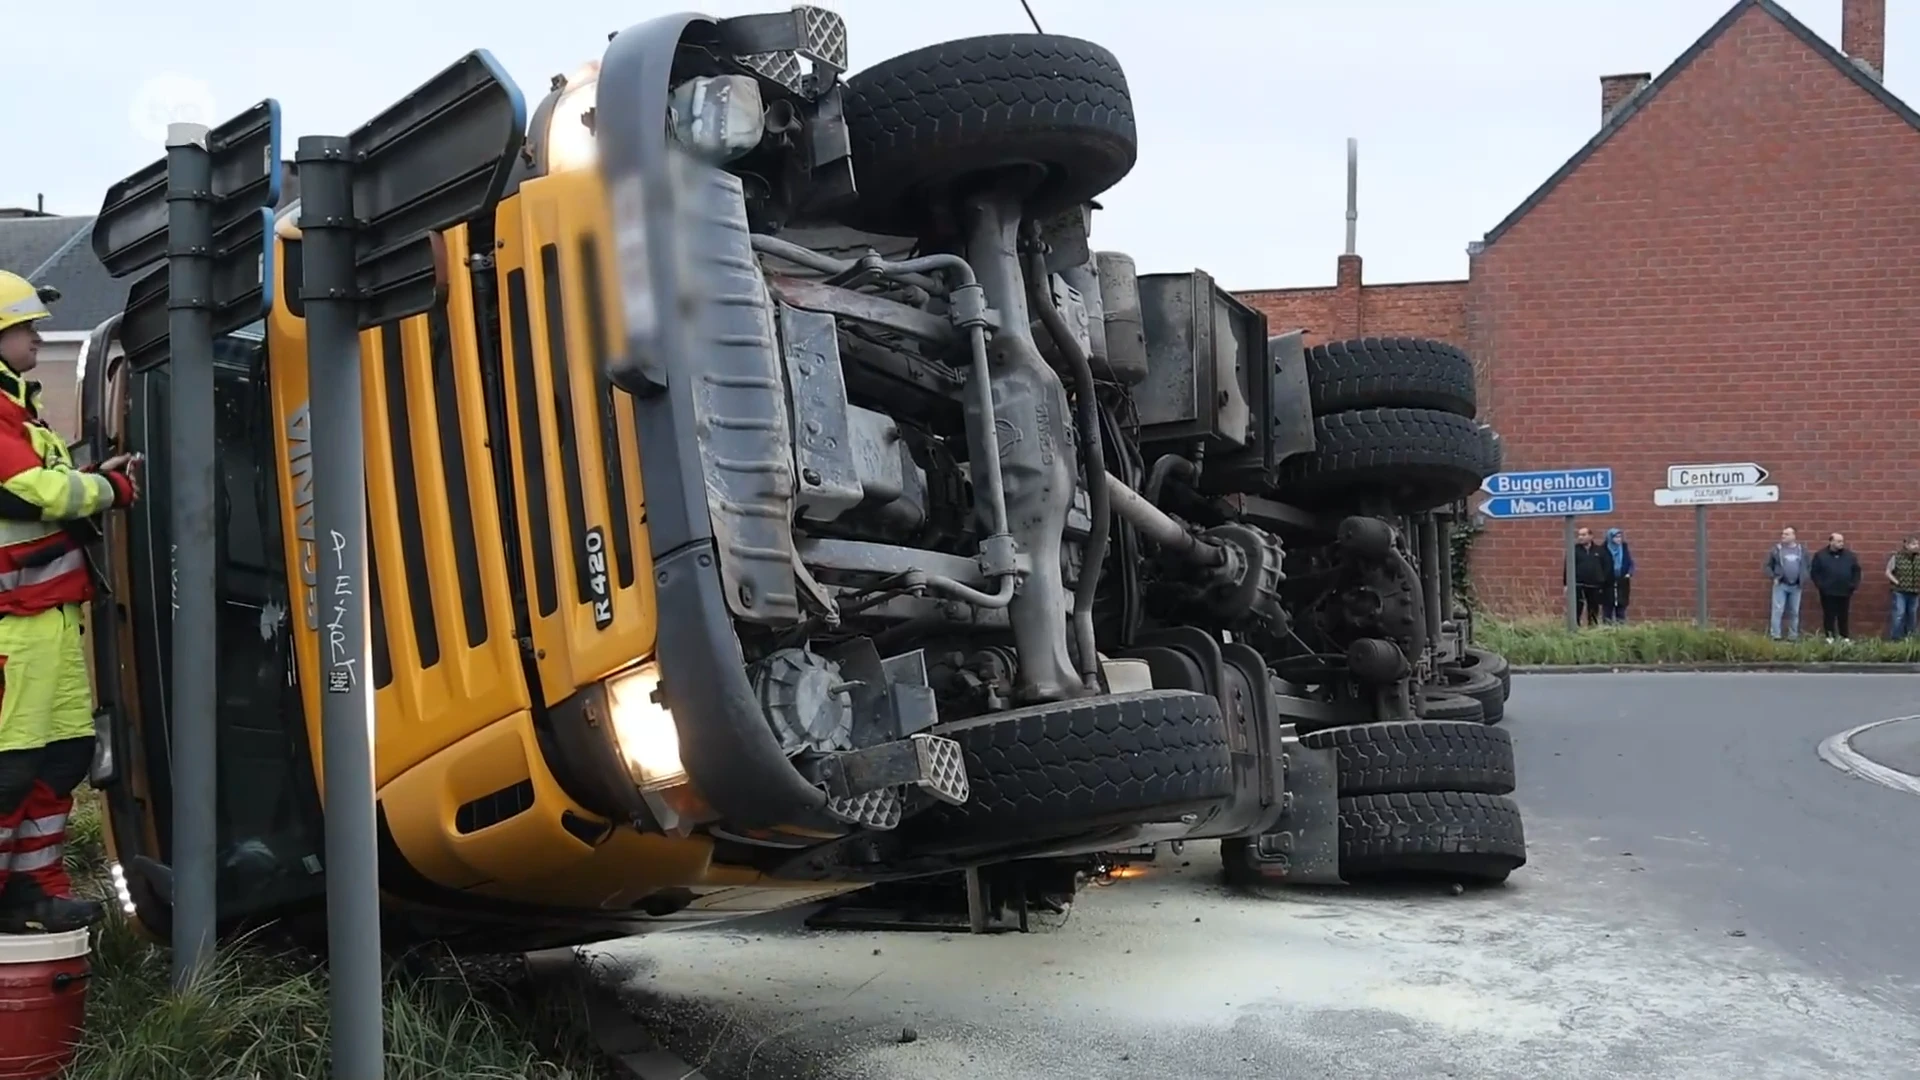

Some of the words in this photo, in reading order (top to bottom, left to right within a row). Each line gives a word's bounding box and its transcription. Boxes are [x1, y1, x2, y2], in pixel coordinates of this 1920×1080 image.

[1498, 472, 1604, 494] Buggenhout
[1680, 470, 1745, 485] Centrum
[1510, 496, 1594, 514] Mchelen
[586, 532, 606, 595] 420
[595, 598, 611, 622] R
